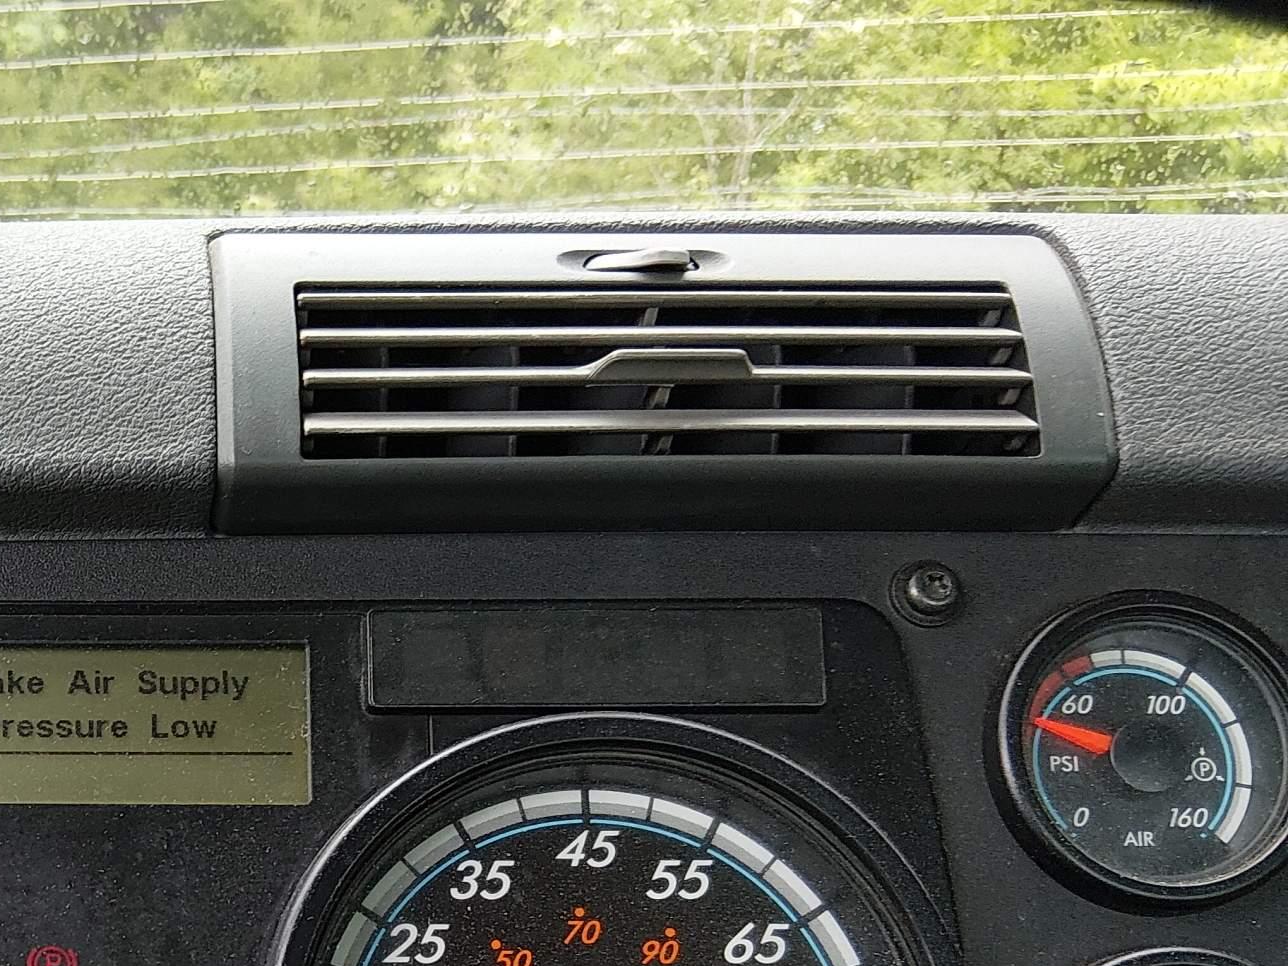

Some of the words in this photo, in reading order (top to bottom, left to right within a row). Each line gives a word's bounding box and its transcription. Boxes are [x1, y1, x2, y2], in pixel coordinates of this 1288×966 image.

[68, 670, 115, 696] Air
[138, 670, 250, 702] Supply
[1061, 694, 1093, 715] 60
[1146, 694, 1186, 715] 100
[152, 714, 217, 741] Low
[1049, 755, 1079, 773] PSI
[1073, 806, 1090, 828] 0
[1169, 806, 1209, 828] 160
[556, 830, 618, 868] 45
[1123, 831, 1155, 847] AIR
[450, 860, 514, 900] 35
[645, 859, 713, 900] 55
[382, 923, 449, 965] 25
[565, 919, 603, 945] 70
[723, 923, 790, 965] 65
[641, 939, 680, 966] 90
